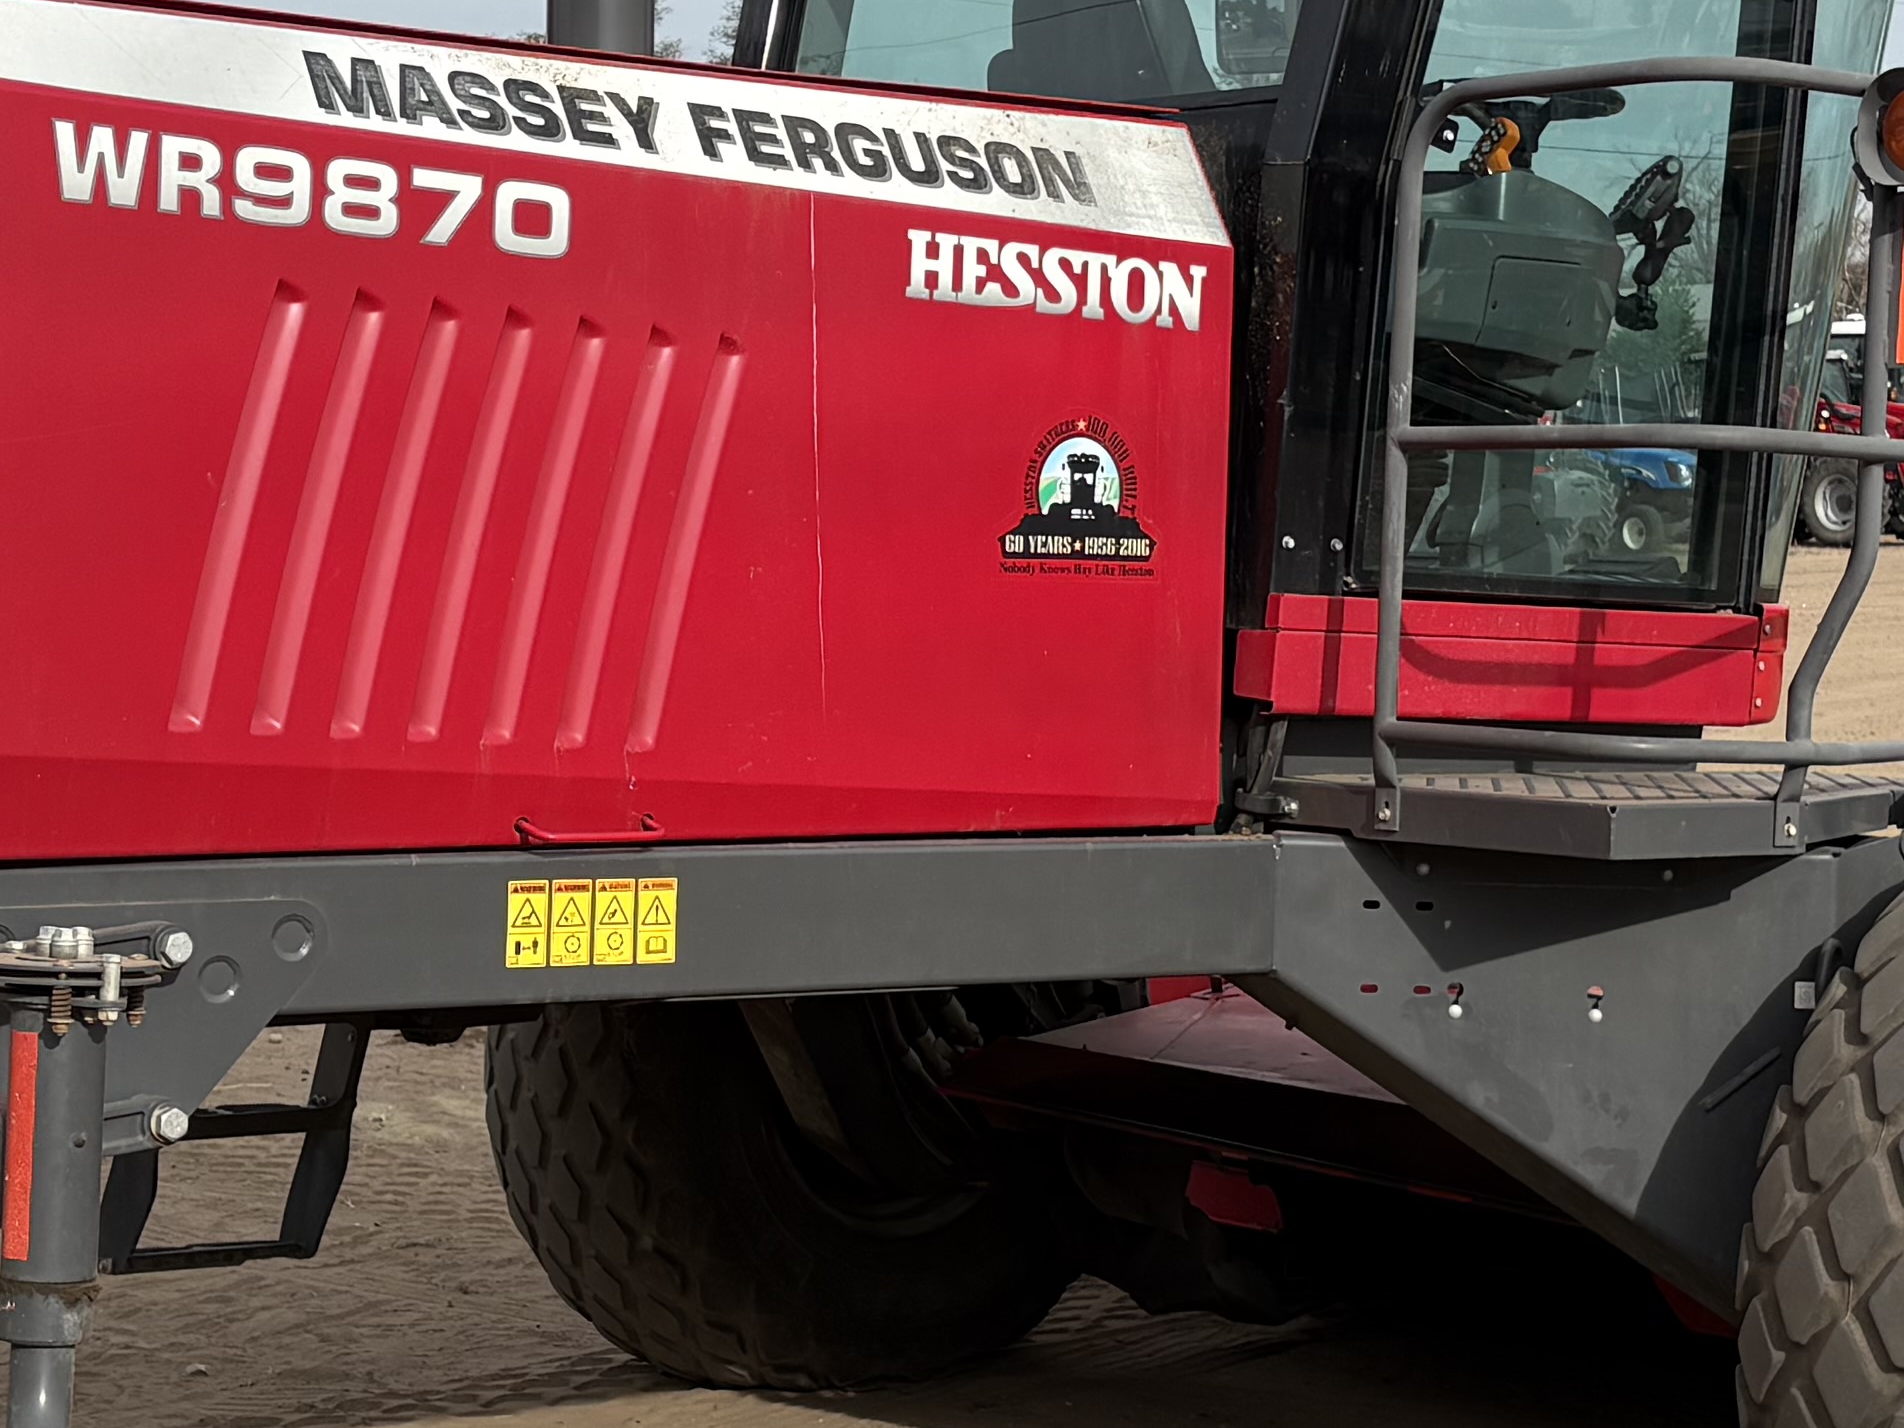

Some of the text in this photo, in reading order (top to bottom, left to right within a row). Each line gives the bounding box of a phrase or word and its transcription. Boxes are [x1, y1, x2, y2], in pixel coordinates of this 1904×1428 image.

[302, 49, 1099, 207] MASSEY FERGUSON
[52, 119, 570, 258] WR9870
[905, 229, 1207, 332] HESSTON
[999, 562, 1035, 576] Nobody
[1005, 534, 1072, 555] 60 YEARS
[1084, 536, 1151, 557] 1956-2016
